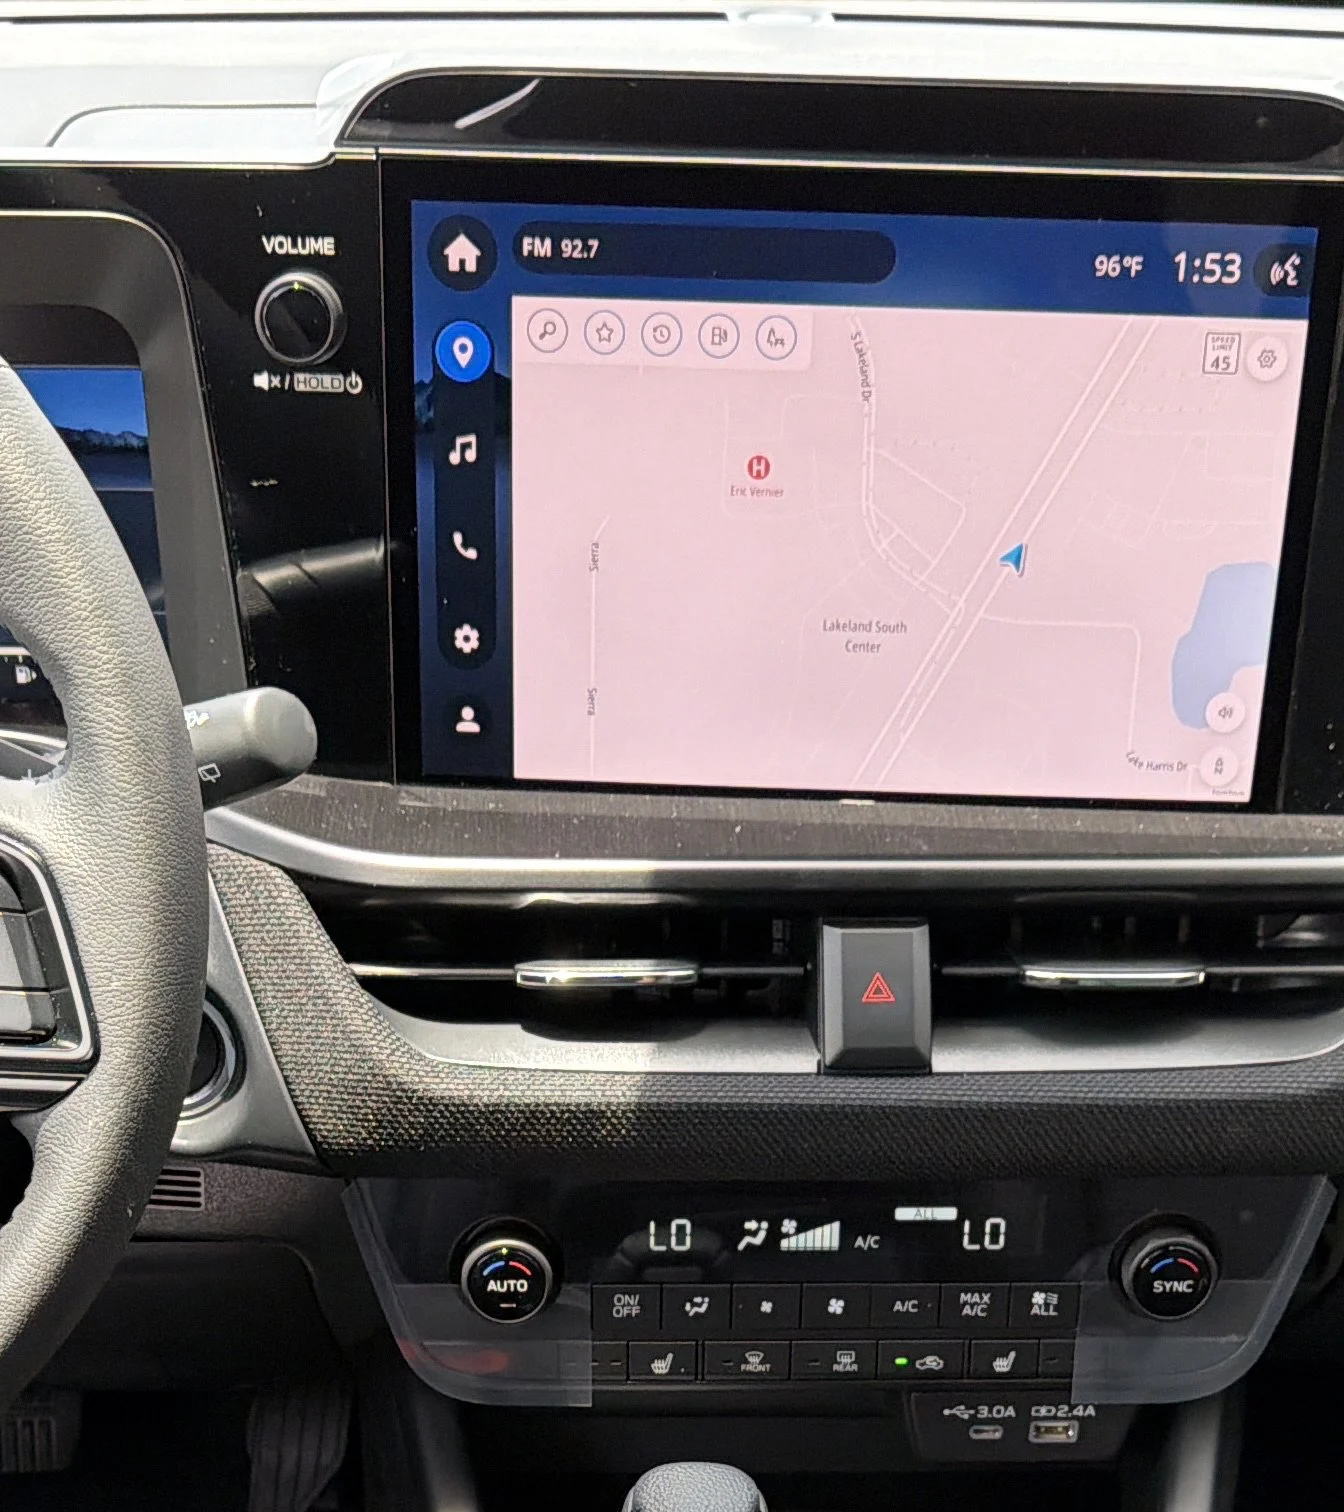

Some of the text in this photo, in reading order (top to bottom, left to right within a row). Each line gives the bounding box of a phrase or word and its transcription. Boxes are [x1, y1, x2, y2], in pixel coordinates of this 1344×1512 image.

[261, 235, 336, 256] VOLUME
[522, 236, 599, 260] FM 92.7
[1094, 254, 1144, 278] 96°F
[1173, 251, 1242, 285] 1:53
[1210, 355, 1231, 371] 45
[295, 375, 343, 390] HOLD
[822, 618, 908, 634] Lakeland South
[844, 639, 882, 654] Center
[854, 1235, 880, 1250] A/C
[487, 1279, 528, 1293] AUTO
[1152, 1280, 1195, 1294] SYNC
[959, 1292, 991, 1304] MAX
[612, 1306, 641, 1318] OFF
[893, 1301, 919, 1313] A/C
[961, 1305, 988, 1317] A/C
[1030, 1305, 1059, 1316] ALL
[740, 1363, 772, 1373] FRONT
[832, 1363, 858, 1373] REAR
[976, 1405, 1097, 1418] 3.0A 2.4A
